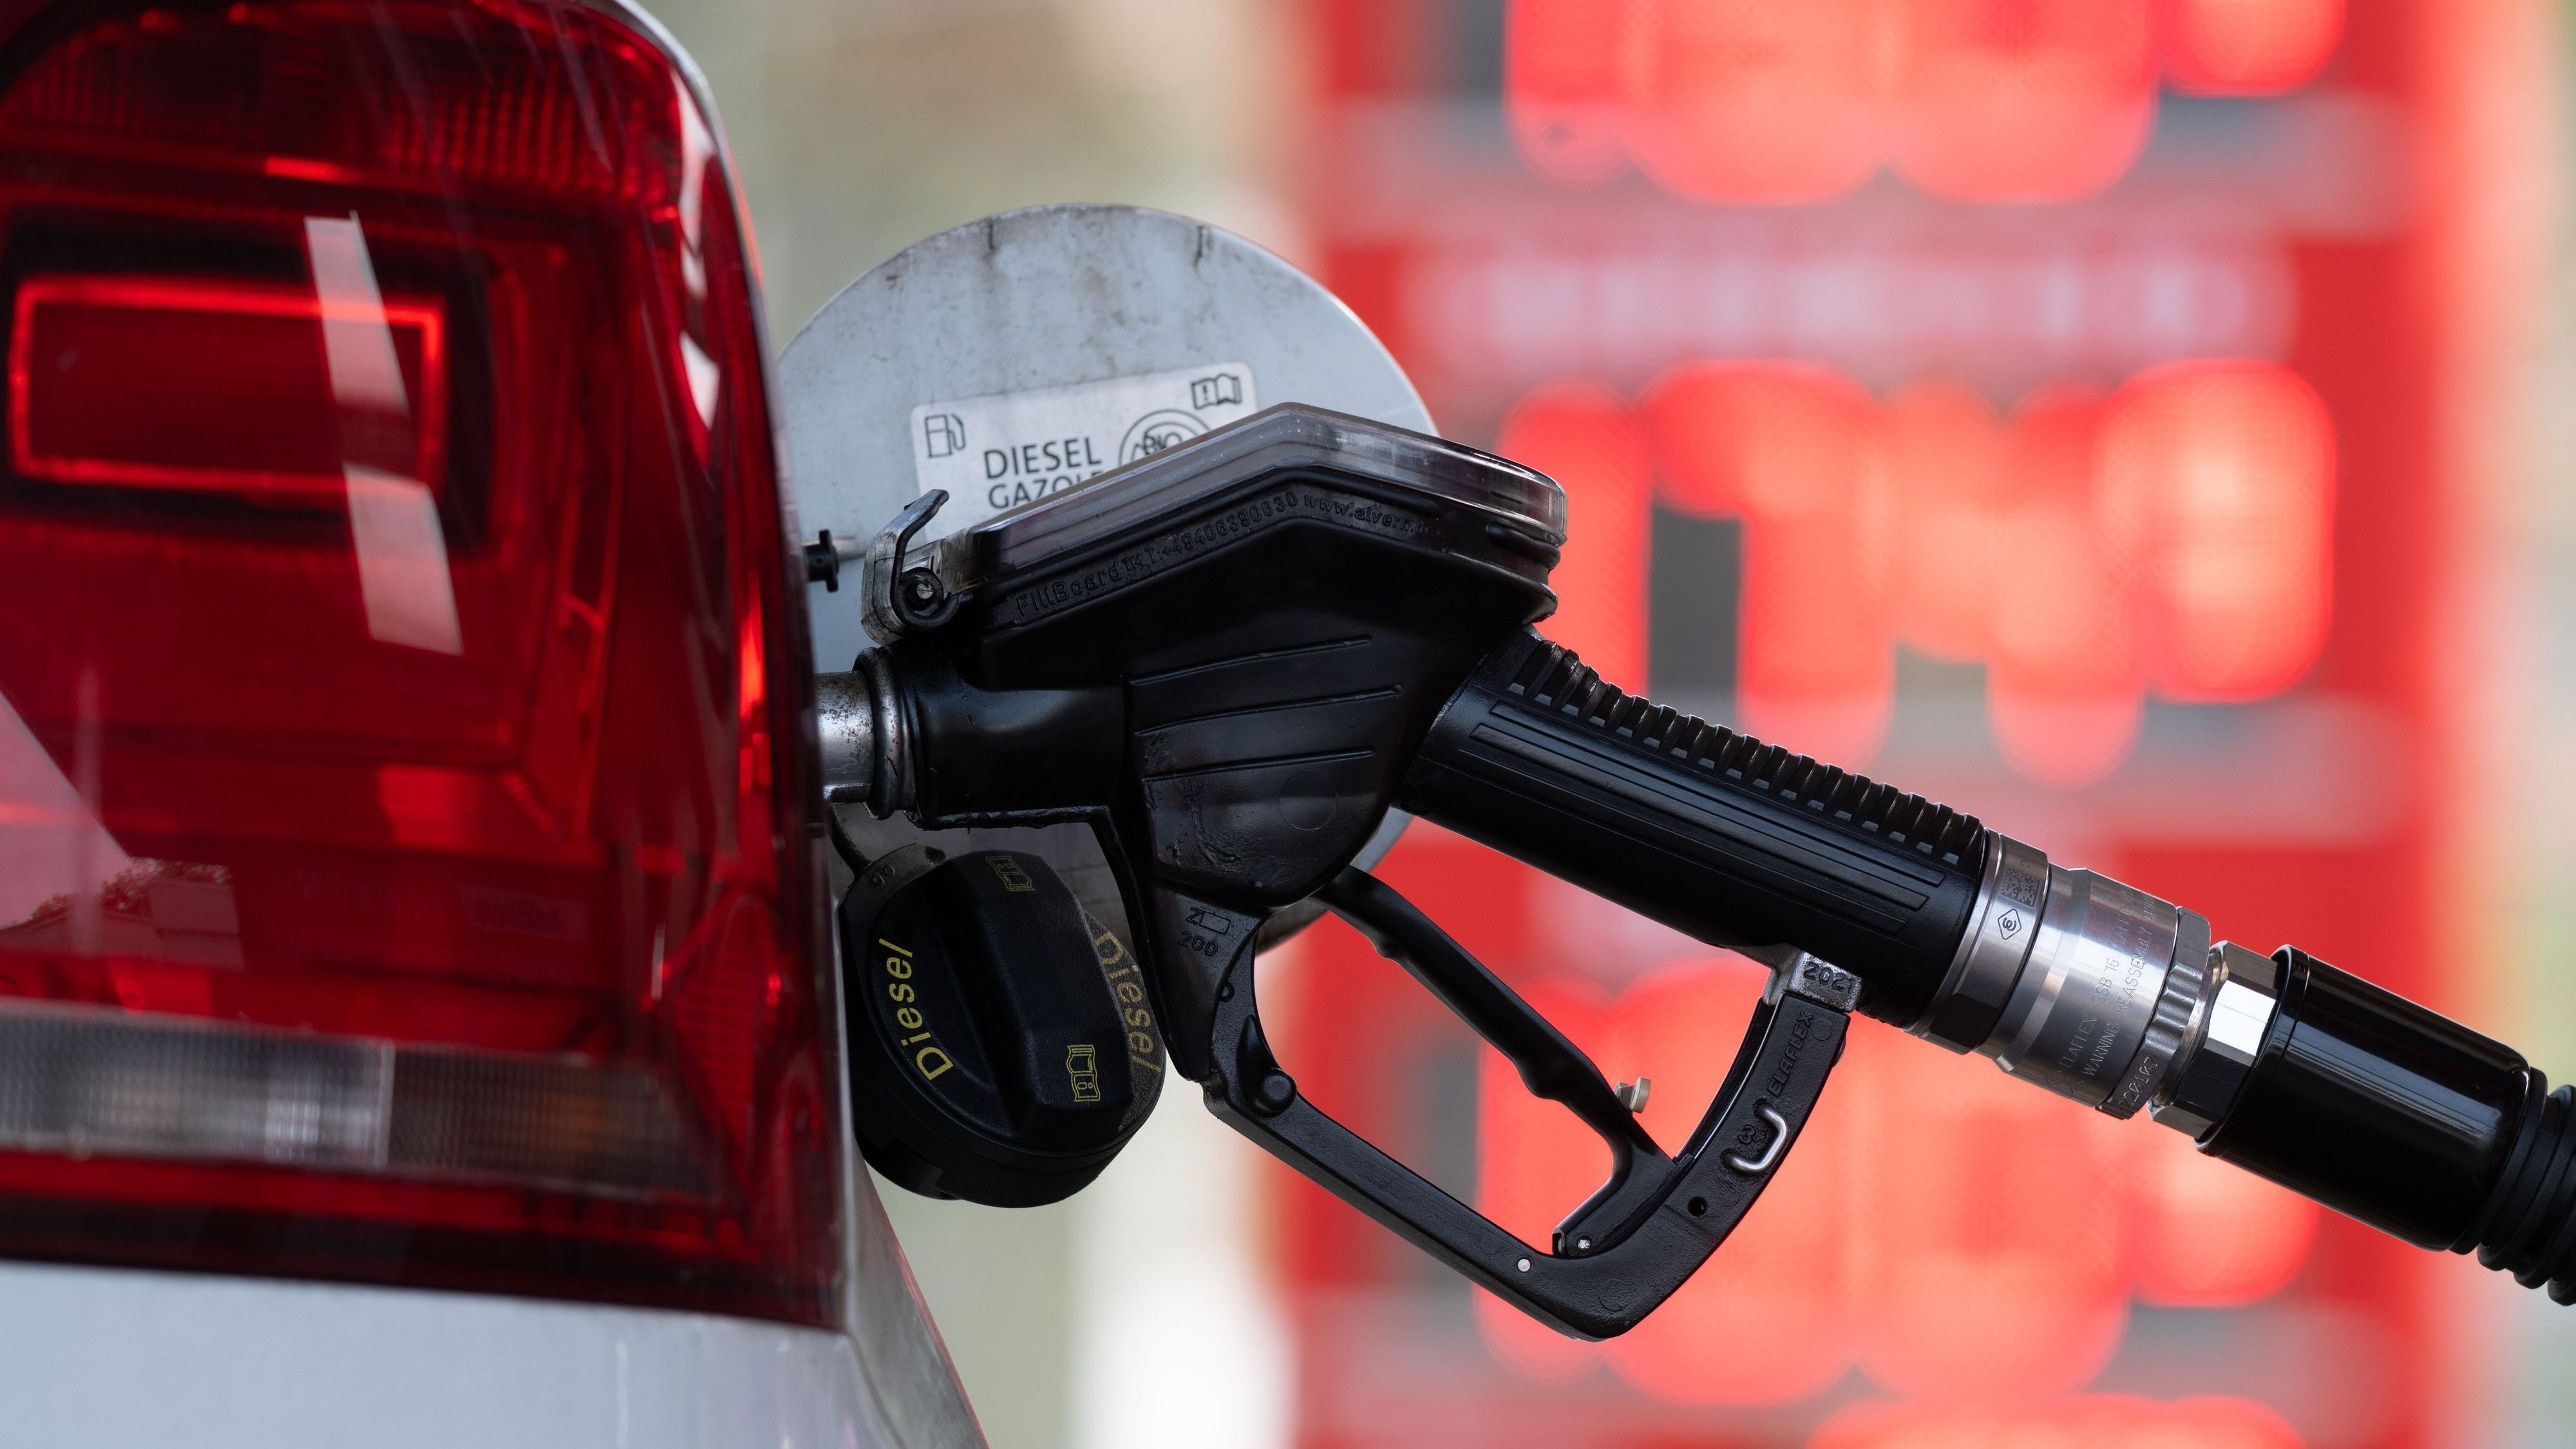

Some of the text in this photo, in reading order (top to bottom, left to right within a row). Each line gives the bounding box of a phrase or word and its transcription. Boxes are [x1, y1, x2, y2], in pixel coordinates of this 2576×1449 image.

[983, 437, 1102, 480] DIESEL
[1177, 931, 1219, 957] 200
[878, 938, 954, 1081] Diesel
[1095, 932, 1160, 1072] Diesel
[2060, 1014, 2098, 1069] ELAFLEX
[2092, 977, 2113, 1005] SSB
[2105, 958, 2121, 975] 16
[1766, 1010, 1815, 1097] ELAFLEX
[2081, 1021, 2120, 1077] WARNING
